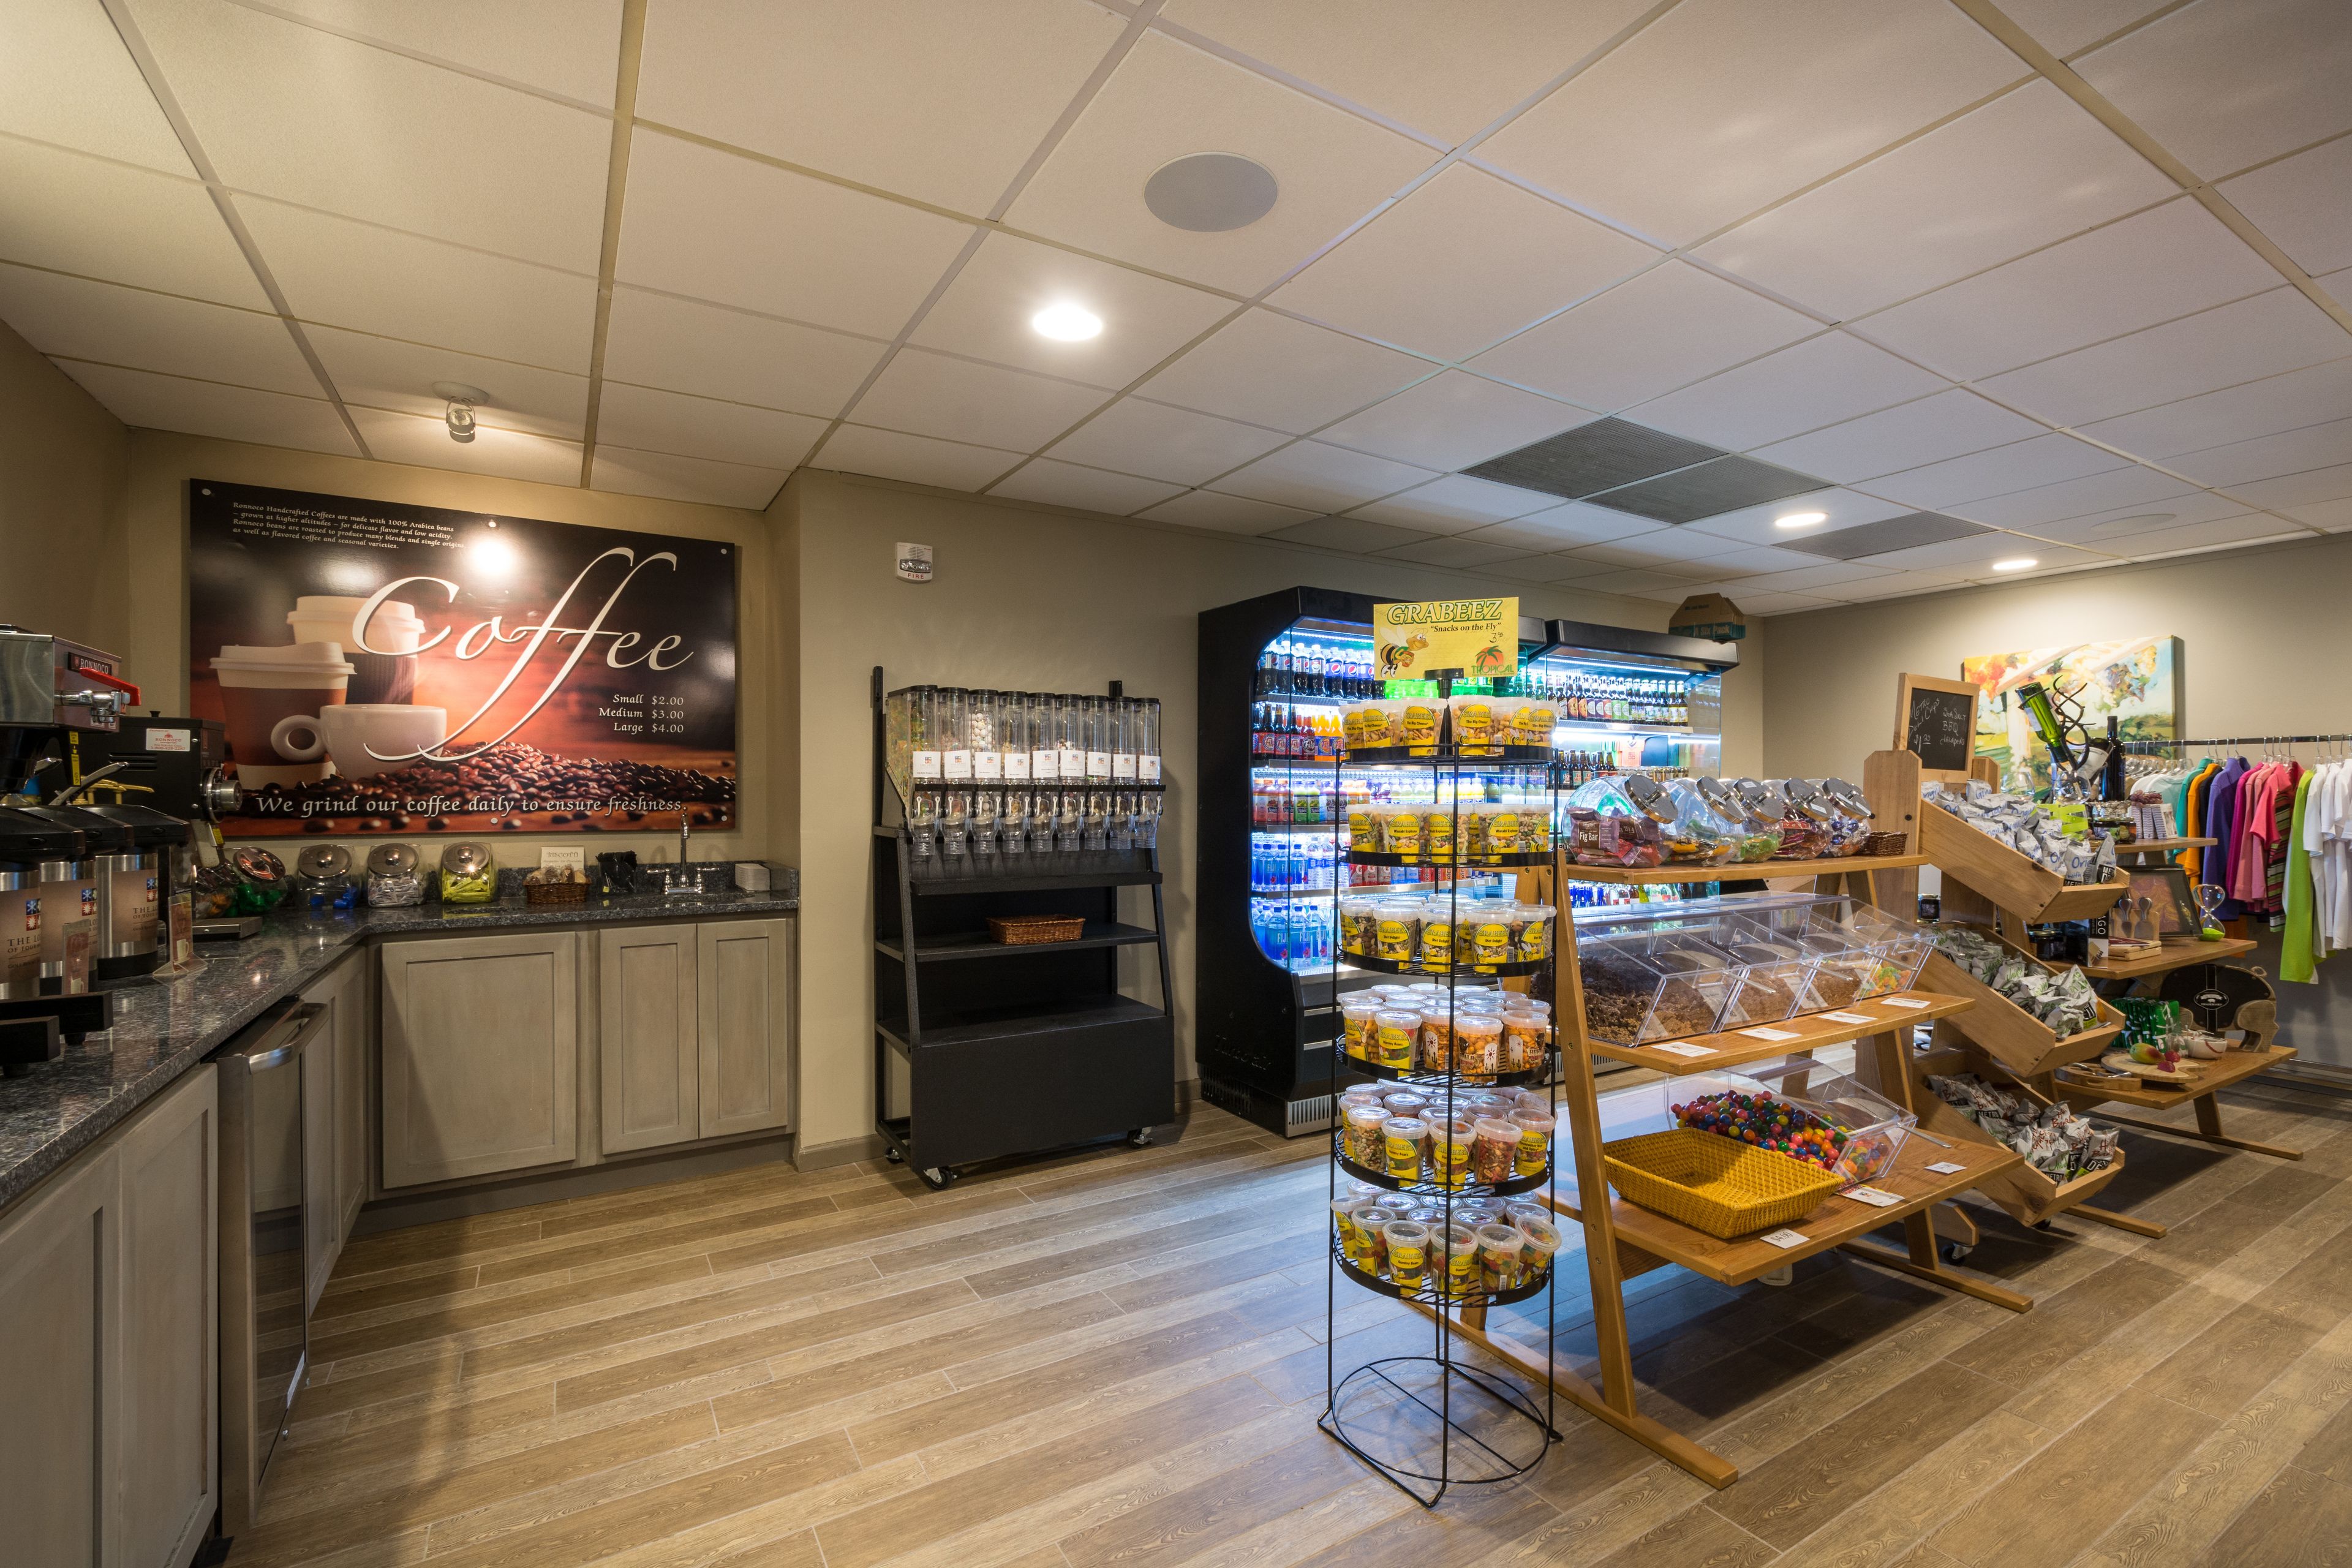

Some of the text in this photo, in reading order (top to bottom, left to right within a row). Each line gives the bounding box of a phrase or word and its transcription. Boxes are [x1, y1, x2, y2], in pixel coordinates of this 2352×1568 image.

[233, 502, 264, 511] Ronnoco
[266, 506, 309, 516] Handcrafted
[311, 511, 335, 520] Coffees
[410, 522, 434, 530] Arabica
[233, 519, 264, 527] Ronnoco
[276, 514, 298, 524] higher
[301, 518, 331, 527] altitudes
[352, 523, 378, 532] delicate
[379, 526, 399, 534] flavor
[428, 532, 453, 541] acidity.
[271, 530, 300, 539] flavored
[1387, 600, 1503, 625] GRABEEZ
[352, 547, 694, 763] Coffee
[80, 658, 108, 674] RONNOCO
[1471, 664, 1514, 674] TROPICAL
[613, 694, 684, 706] Small $2.00
[598, 707, 684, 719] Medium $3.00
[614, 722, 684, 734] Large $4.00
[1942, 720, 1959, 736] BBQ
[255, 796, 687, 818] We grind our coffee daily to ensure freshness.
[7, 937, 30, 946] THE
[1300, 932, 1310, 941] FIJI
